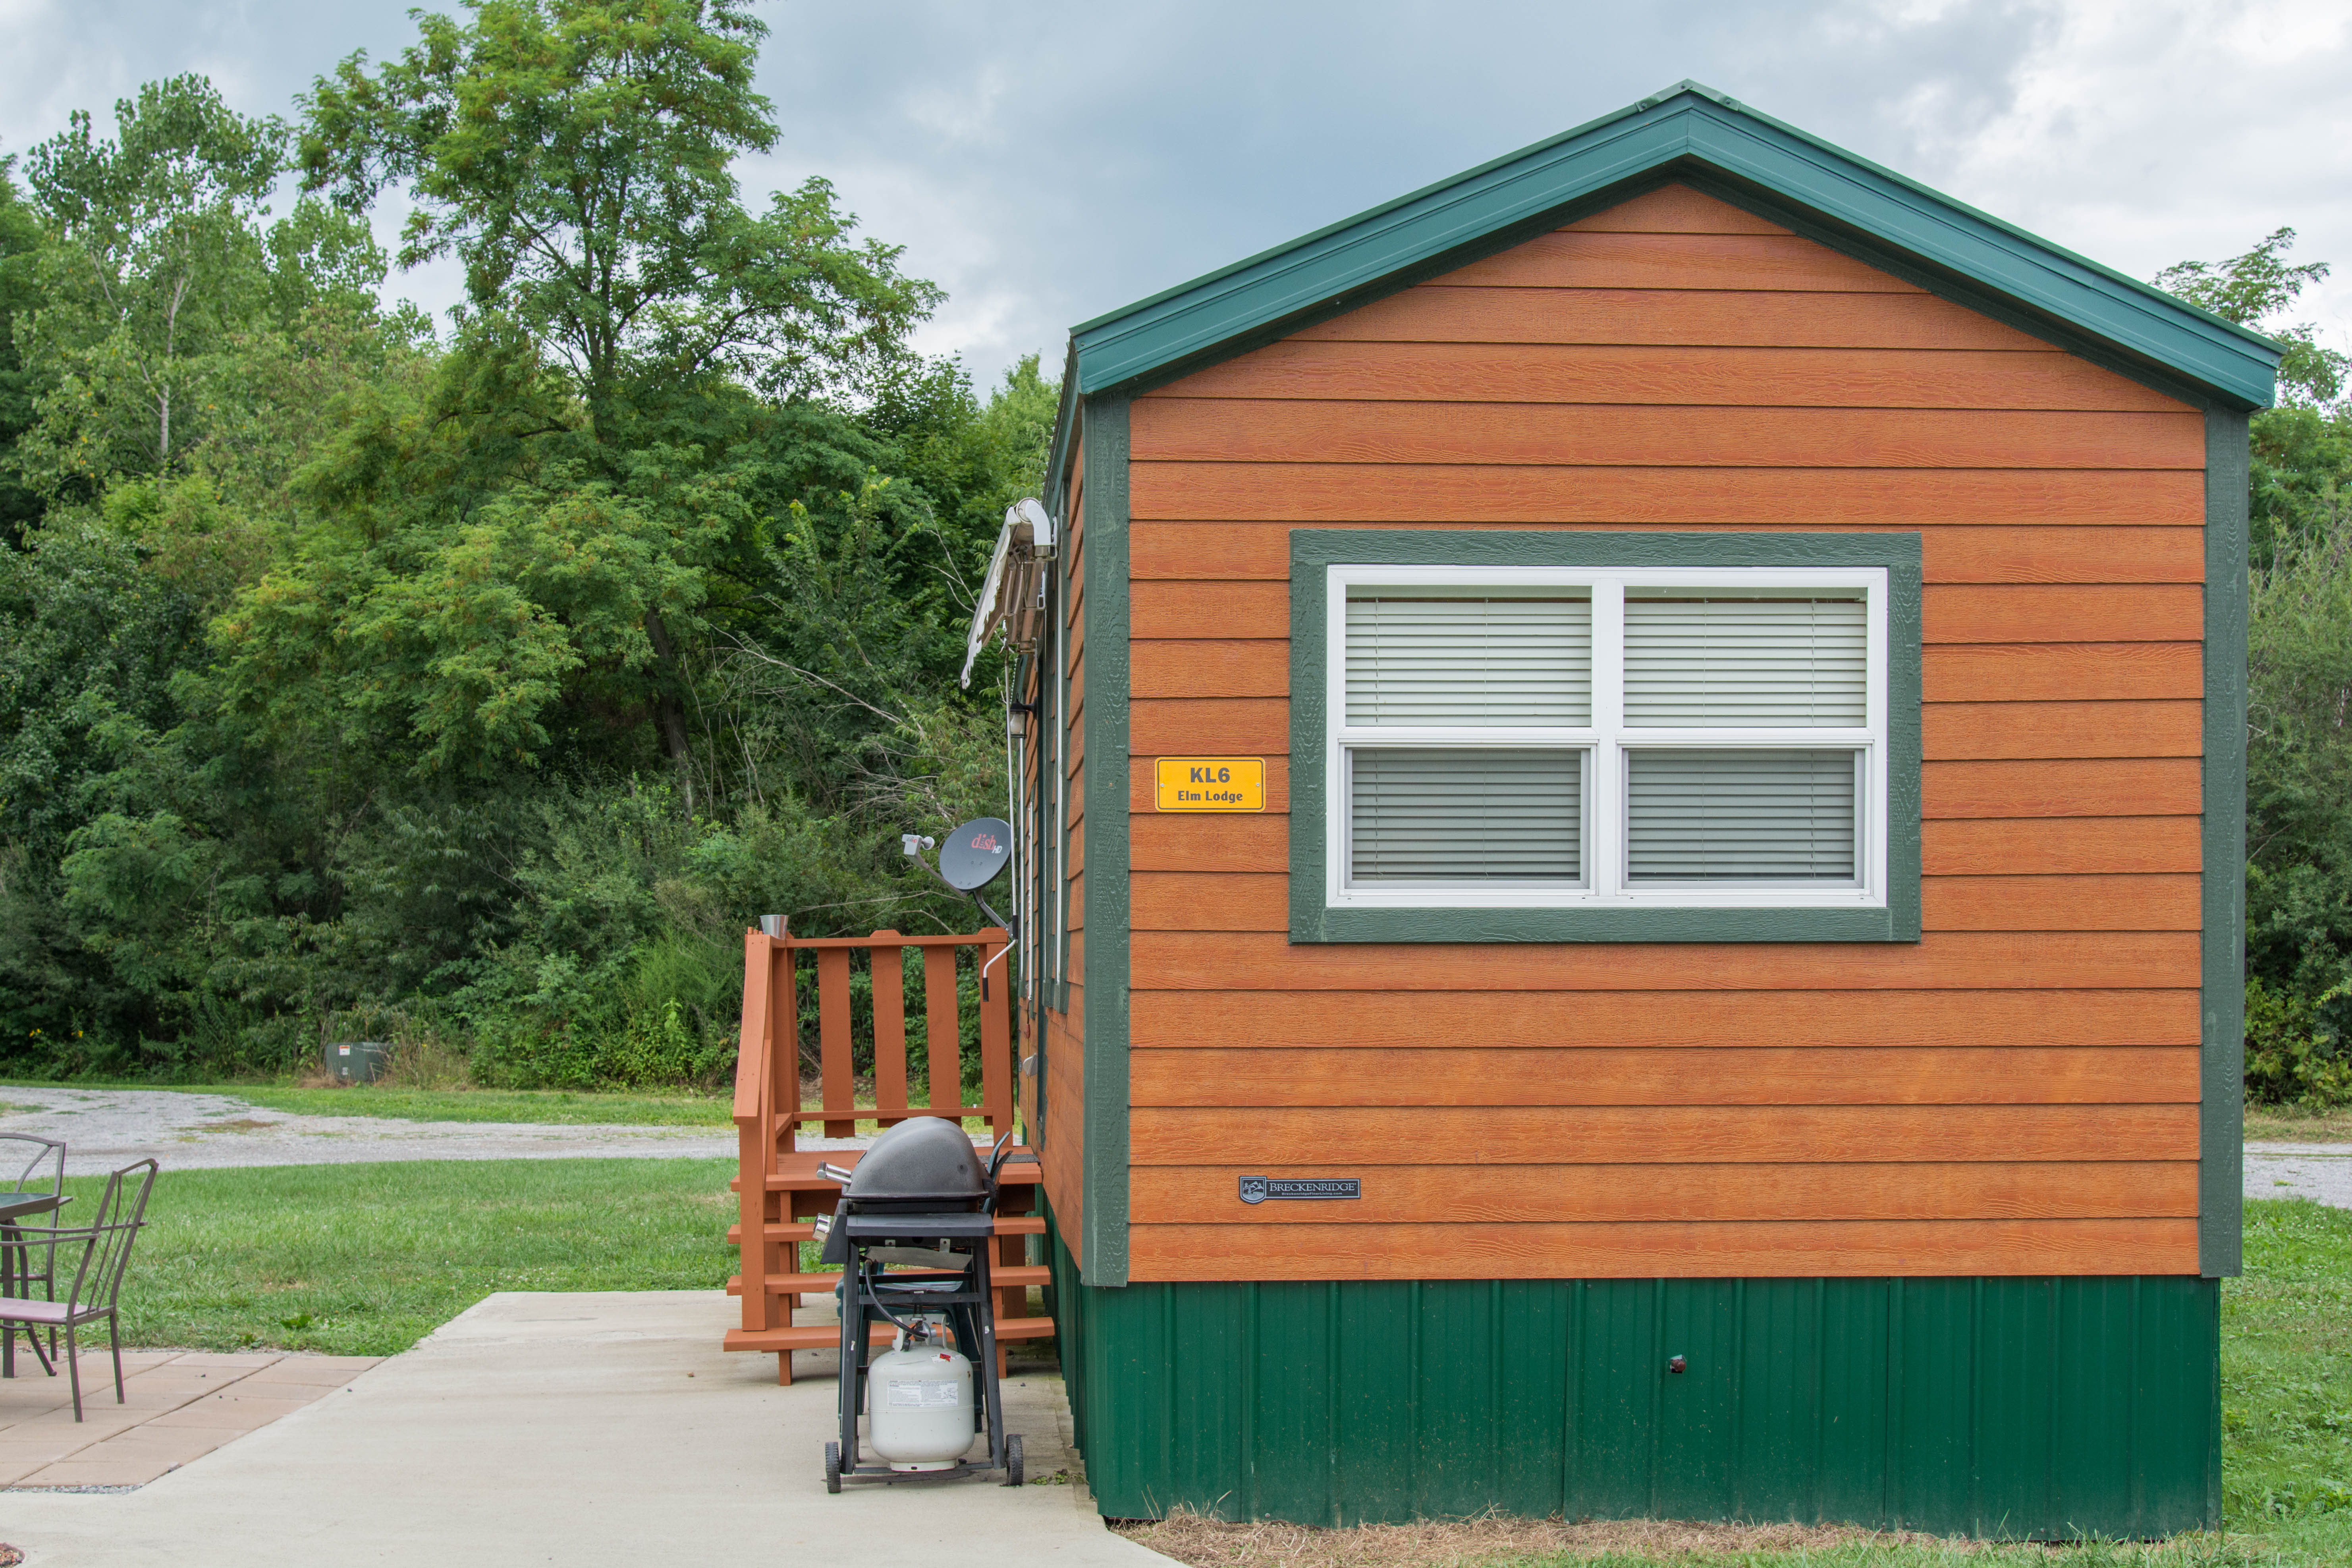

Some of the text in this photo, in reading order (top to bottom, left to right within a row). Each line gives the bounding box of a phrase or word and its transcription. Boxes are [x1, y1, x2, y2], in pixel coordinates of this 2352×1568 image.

[1190, 768, 1230, 783] KL6
[1178, 791, 1243, 803] Elm Lodge
[971, 833, 1003, 854] dish HD
[1269, 1183, 1355, 1191] BRECKENRIDGE
